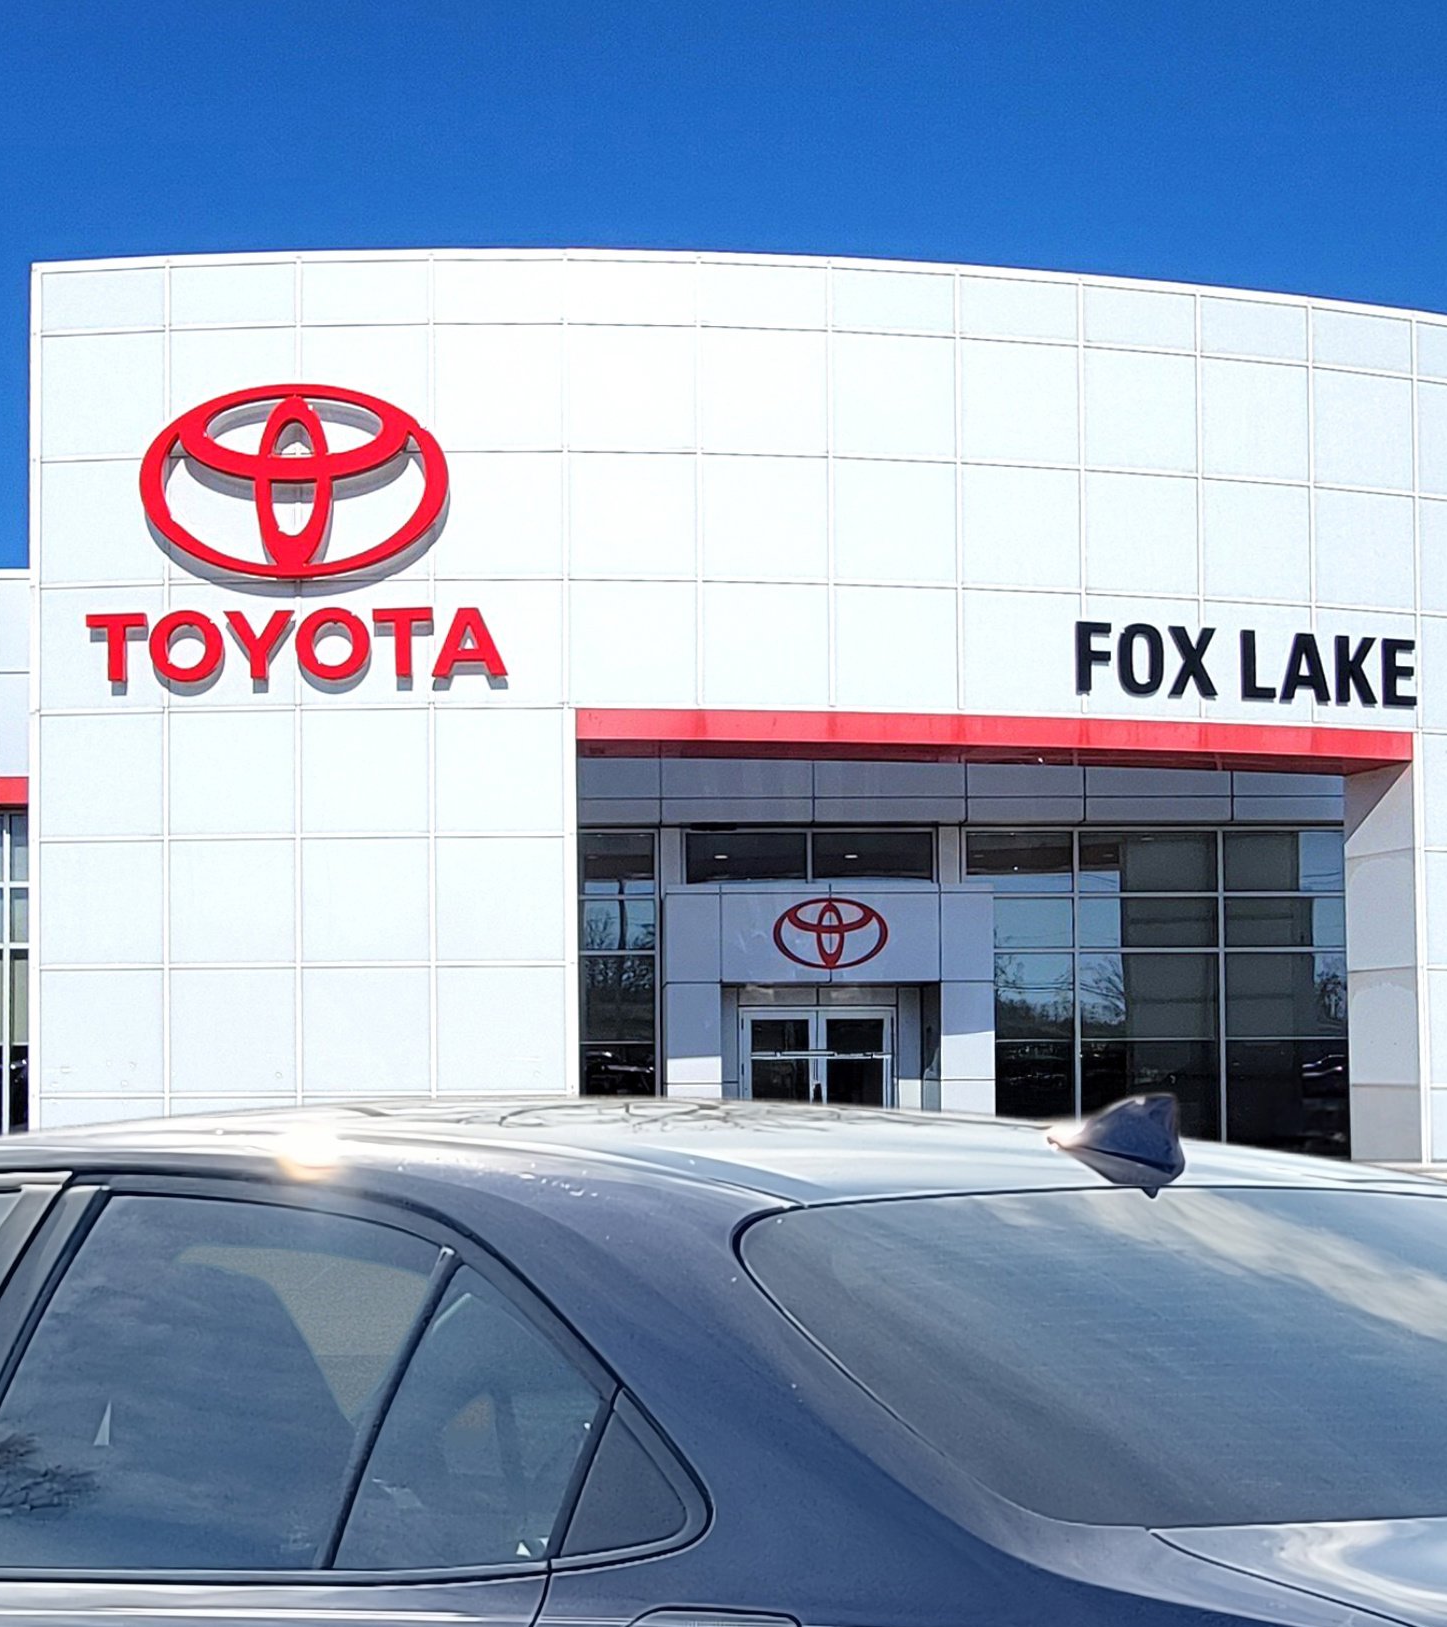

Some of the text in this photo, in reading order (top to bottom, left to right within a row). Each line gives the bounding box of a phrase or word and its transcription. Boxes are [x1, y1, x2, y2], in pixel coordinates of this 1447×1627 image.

[85, 607, 509, 690] TOYOTA
[1074, 620, 1418, 708] FOX LAKE
